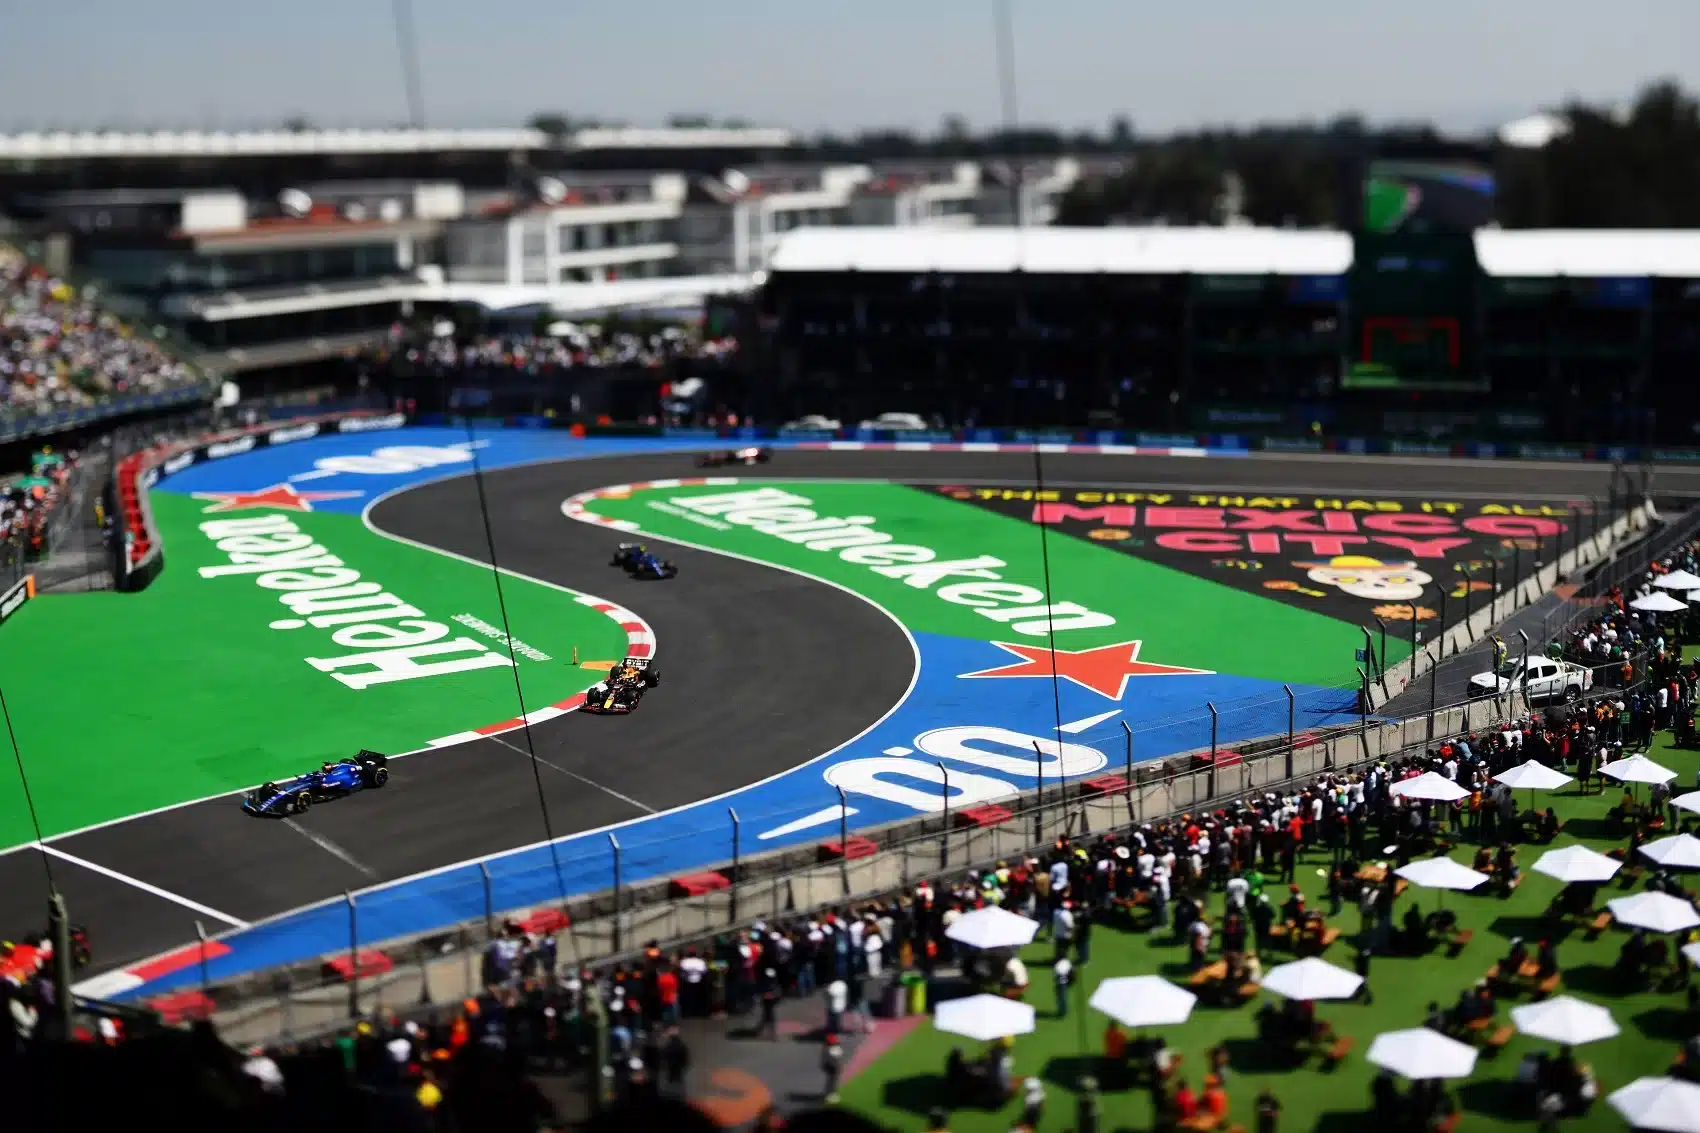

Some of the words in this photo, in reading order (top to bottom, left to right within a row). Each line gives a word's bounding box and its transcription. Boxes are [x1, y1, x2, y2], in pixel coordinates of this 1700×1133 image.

[976, 488, 1060, 502] THE
[1075, 491, 1172, 504] CITY
[1189, 494, 1299, 508] THAT
[1313, 498, 1403, 511] HAS
[1420, 501, 1465, 513] IT
[1480, 503, 1570, 516] ALL
[1031, 502, 1569, 536] MEXICO
[1154, 530, 1473, 558] CITY
[669, 487, 1116, 636] Heineken
[198, 514, 520, 690] Heineken
